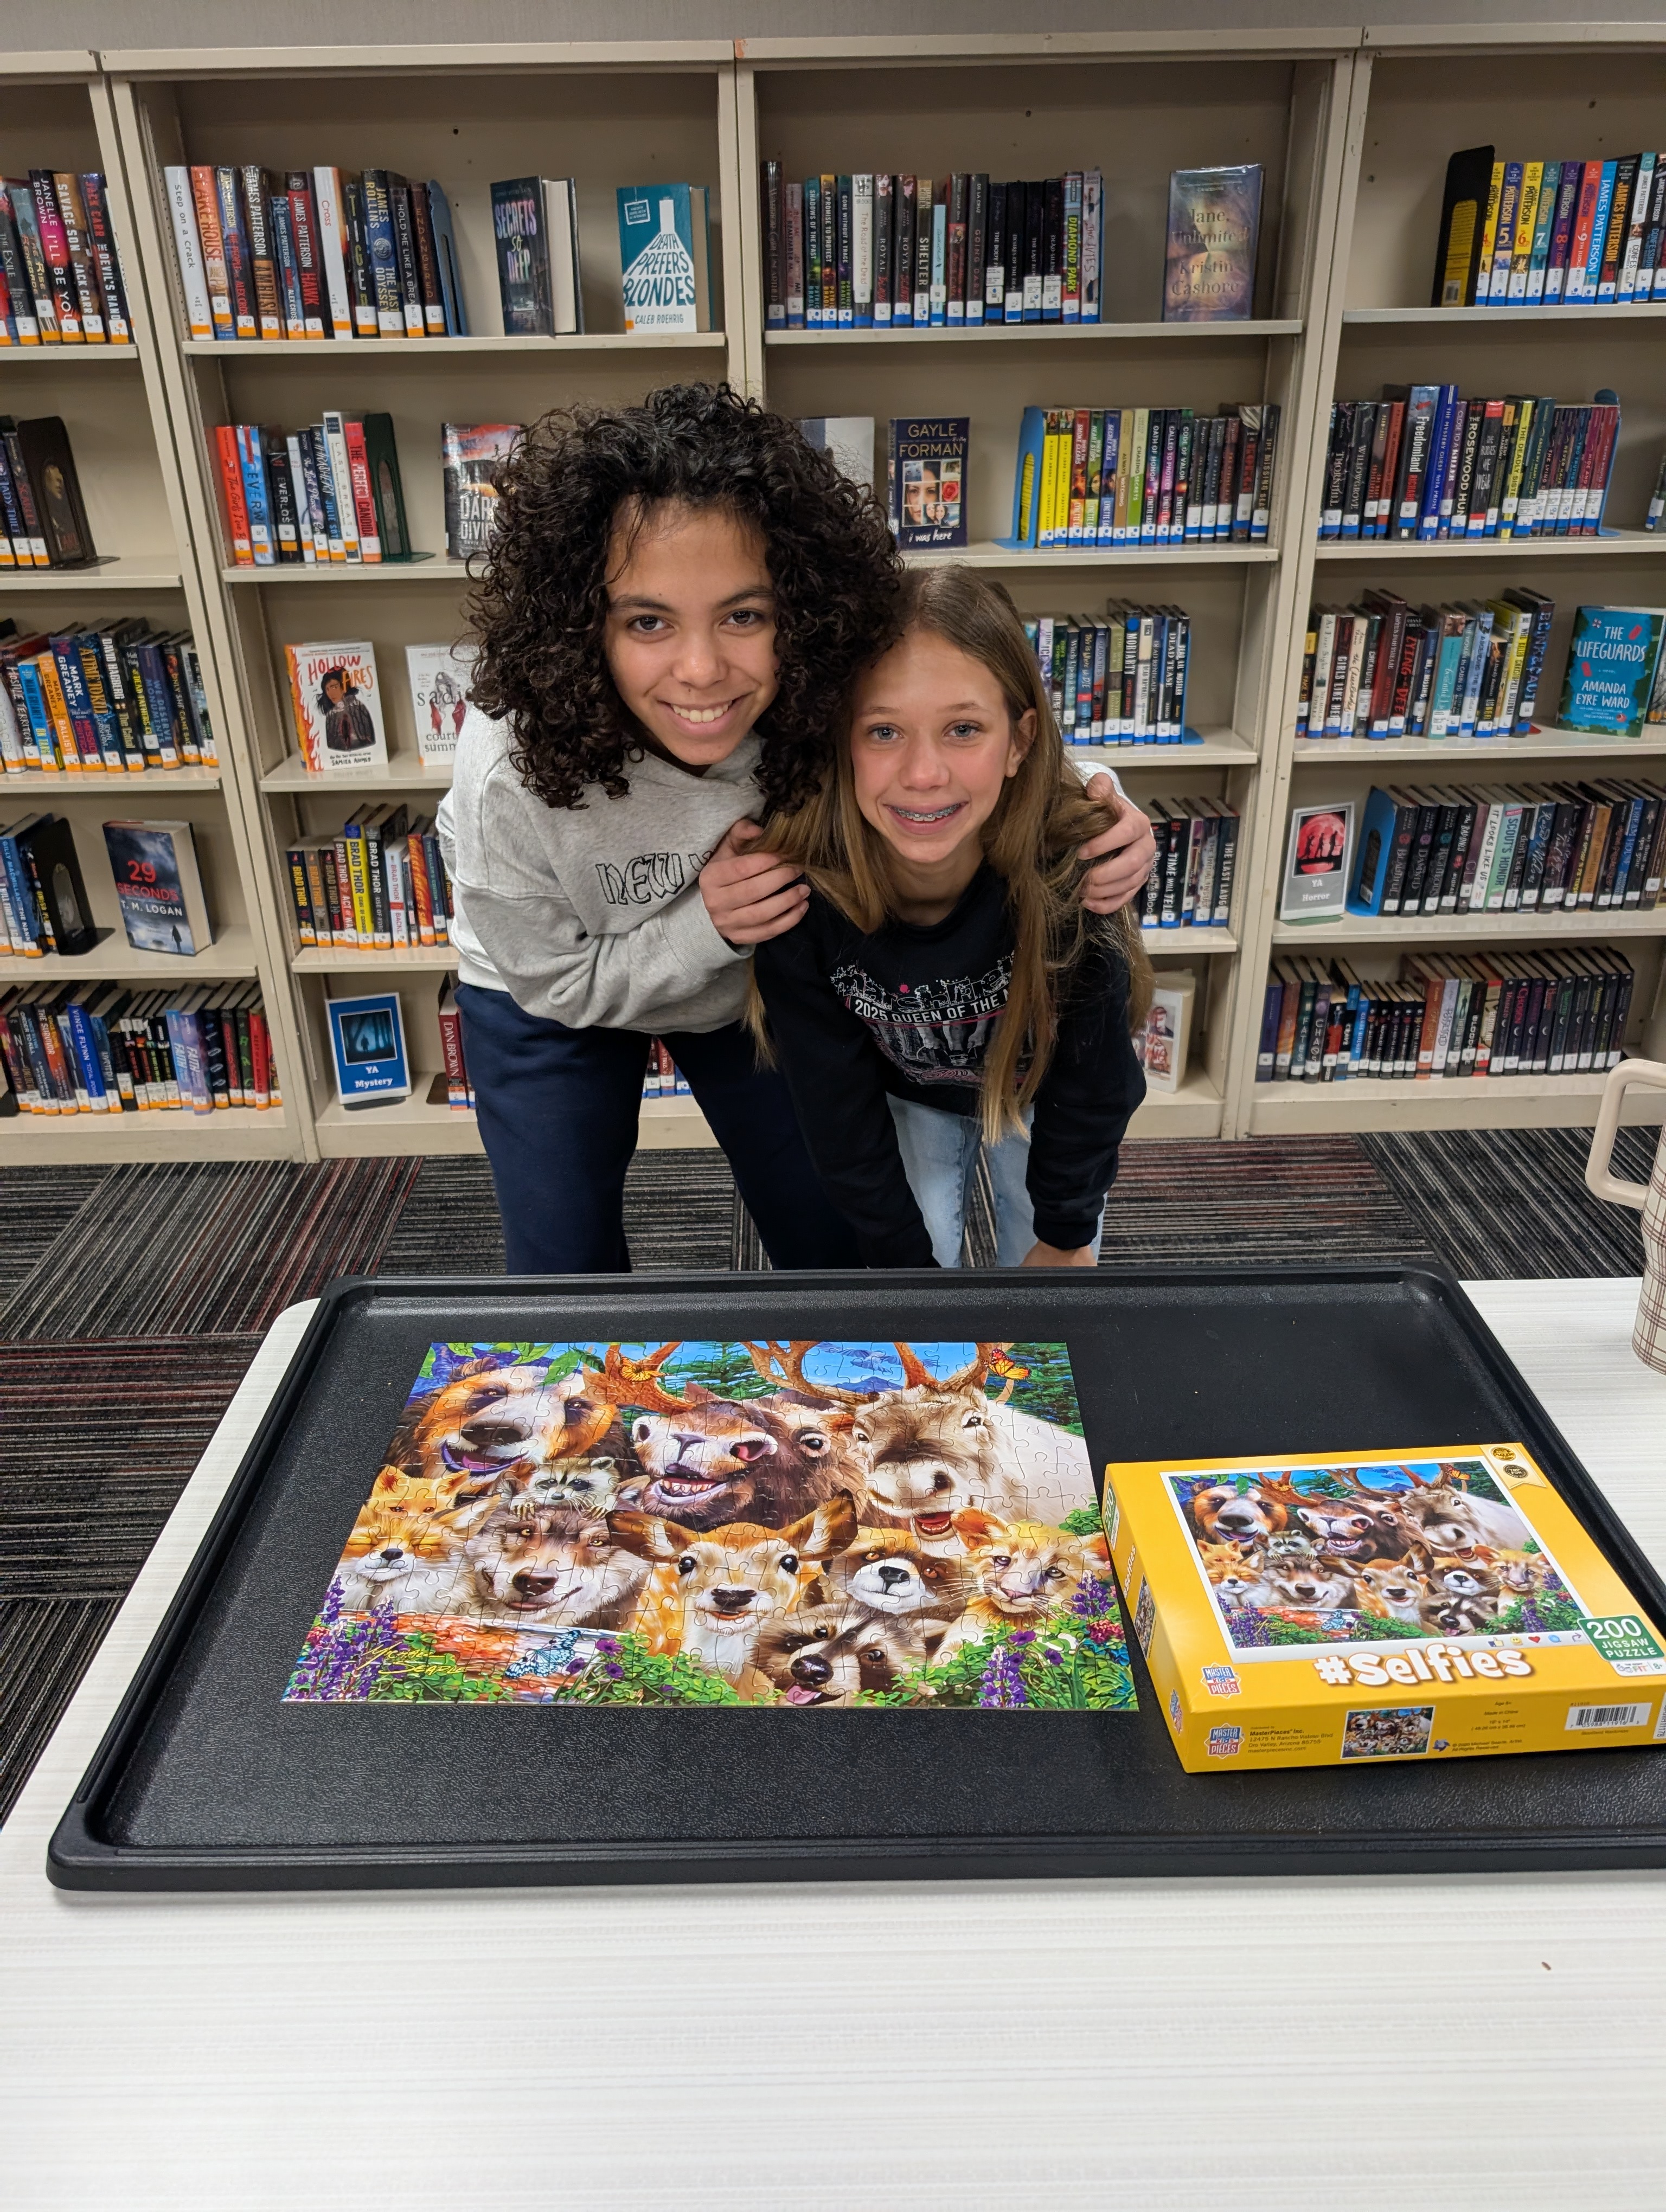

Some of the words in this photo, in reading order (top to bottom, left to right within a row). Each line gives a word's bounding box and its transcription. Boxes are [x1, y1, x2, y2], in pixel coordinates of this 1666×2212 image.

[246, 172, 260, 203] JAMES
[1641, 175, 1649, 189] JAMES
[33, 182, 47, 223] BROWN
[41, 178, 57, 226] JANELLE
[57, 184, 75, 225] SAVAGE
[366, 182, 379, 229] ROLLINS
[376, 188, 389, 222] JAMES
[1500, 186, 1516, 224] PATTERSON
[1521, 186, 1534, 224] PATTERSON
[1599, 180, 1611, 211] JAMES
[1614, 182, 1629, 212] JAMES
[1637, 190, 1646, 215] PATTERSON
[293, 197, 306, 222] JAMES
[322, 201, 331, 227] Cross
[495, 200, 537, 240] SECRETS
[174, 185, 184, 208] Step
[180, 213, 187, 224] on
[184, 240, 196, 268] Crack
[251, 206, 267, 255] PATTERSON
[1606, 214, 1624, 262] PATTERSON
[68, 230, 80, 251] SON
[297, 226, 312, 267] PATTERSON
[651, 234, 679, 250] DEATH
[1067, 217, 1077, 263] DIAMOND
[1588, 215, 1605, 272] PATTERSON
[47, 235, 60, 260] I'LL
[54, 267, 66, 285] BE
[416, 209, 433, 298] ENDANGERED
[628, 251, 689, 275] PREFERS
[918, 237, 928, 286] SHELTER
[74, 262, 87, 290] JACK
[99, 253, 115, 291] DEVIL'S
[1067, 267, 1077, 292] PARK
[1180, 261, 1233, 274] Kristin
[255, 266, 277, 316] AMBUSH
[301, 273, 319, 305] HAWK
[375, 267, 389, 312] ODYSSEY
[623, 275, 695, 307] BLONDES
[1172, 280, 1239, 295] Cashore
[80, 290, 93, 313] CARR
[106, 295, 120, 320] HAND
[635, 314, 655, 325] CALEB
[656, 313, 684, 324] ROEHRIG
[908, 423, 957, 438] GAYLE
[899, 443, 963, 458] FORMAN
[1182, 447, 1188, 456] OF
[1409, 416, 1430, 472] Freedomland
[1180, 458, 1188, 480] VALOR
[1330, 452, 1345, 506] THORNHILL
[1350, 445, 1367, 510] WILLOWGROVE
[1405, 475, 1418, 501] RICHARD
[1167, 632, 1176, 658] DEAD
[1605, 626, 1624, 640] THE
[101, 639, 118, 662] DAVID
[1125, 633, 1137, 675] MORIARTY
[1401, 636, 1417, 676] LYING
[1577, 641, 1647, 662] LIFEGUARDS
[308, 655, 361, 685] HOLLOW
[342, 666, 373, 692] FIRES
[1166, 660, 1175, 687] TEASE
[1336, 655, 1348, 680] GIRLS
[44, 674, 57, 709] GREANEY
[52, 681, 62, 702] MARK
[57, 655, 77, 706] GREANEY
[69, 665, 84, 697] MARK
[108, 664, 125, 699] HAGBERG
[132, 676, 144, 693] DEAD
[1332, 683, 1344, 701] LIKE
[1582, 680, 1626, 695] AMANDA
[6, 666, 24, 699] HOSTILE
[16, 703, 33, 747] TERRITORY
[137, 695, 150, 725] FATHERS
[146, 679, 164, 743] MONUMENTS
[152, 680, 162, 695] WE
[158, 700, 172, 741] DESERVE
[1576, 693, 1598, 705] EYRE
[1601, 696, 1630, 709] WARD
[119, 713, 131, 726] The
[120, 728, 135, 748] Cabal
[1486, 821, 1498, 846] LOOKS
[1505, 819, 1518, 853] SCOUT'S
[335, 844, 346, 863] BRAD
[349, 841, 362, 867] BRAD
[368, 842, 379, 867] BRAD
[1483, 850, 1493, 869] LIKE
[127, 859, 157, 883] 29
[292, 865, 303, 884] BRAD
[309, 865, 319, 885] BRAD
[338, 865, 349, 883] THOR
[353, 869, 364, 894] THOR
[371, 869, 381, 893] THOR
[1312, 879, 1323, 888] YA
[1496, 857, 1511, 885] HONOR
[116, 882, 180, 902] SECONDS
[296, 888, 307, 906] THOR
[312, 887, 324, 906] THOR
[342, 896, 352, 908] ACT
[1302, 893, 1330, 902] Horror
[121, 900, 129, 910] T.
[131, 903, 143, 911] M.
[146, 903, 183, 916] LOGAN
[38, 1009, 47, 1021] THE
[855, 999, 888, 1021] 2025
[892, 1010, 941, 1024] QUEEN
[947, 1005, 966, 1019] OF
[974, 994, 1000, 1014] THE
[41, 1023, 55, 1055] SURVIVOR
[73, 1009, 84, 1034] VINCE
[79, 1036, 90, 1060] FLYNN
[444, 1021, 454, 1043] DAN
[174, 1043, 187, 1068] FAITH
[187, 1046, 200, 1072] FAITH
[446, 1044, 459, 1077] BROWN
[366, 1065, 379, 1074] YA
[354, 1078, 393, 1089] Mystery
[1124, 1544, 1136, 1599] #Selfies
[1586, 1618, 1642, 1639] 200
[1601, 1638, 1649, 1649] JIGSAW
[1605, 1647, 1658, 1658] PUZZLE
[1204, 1667, 1231, 1678] MASTER
[1313, 1643, 1535, 1686] #Selfies
[1211, 1683, 1238, 1694] PIECES
[1213, 1728, 1238, 1739] MASTER
[1211, 1744, 1236, 1754] PIECES
